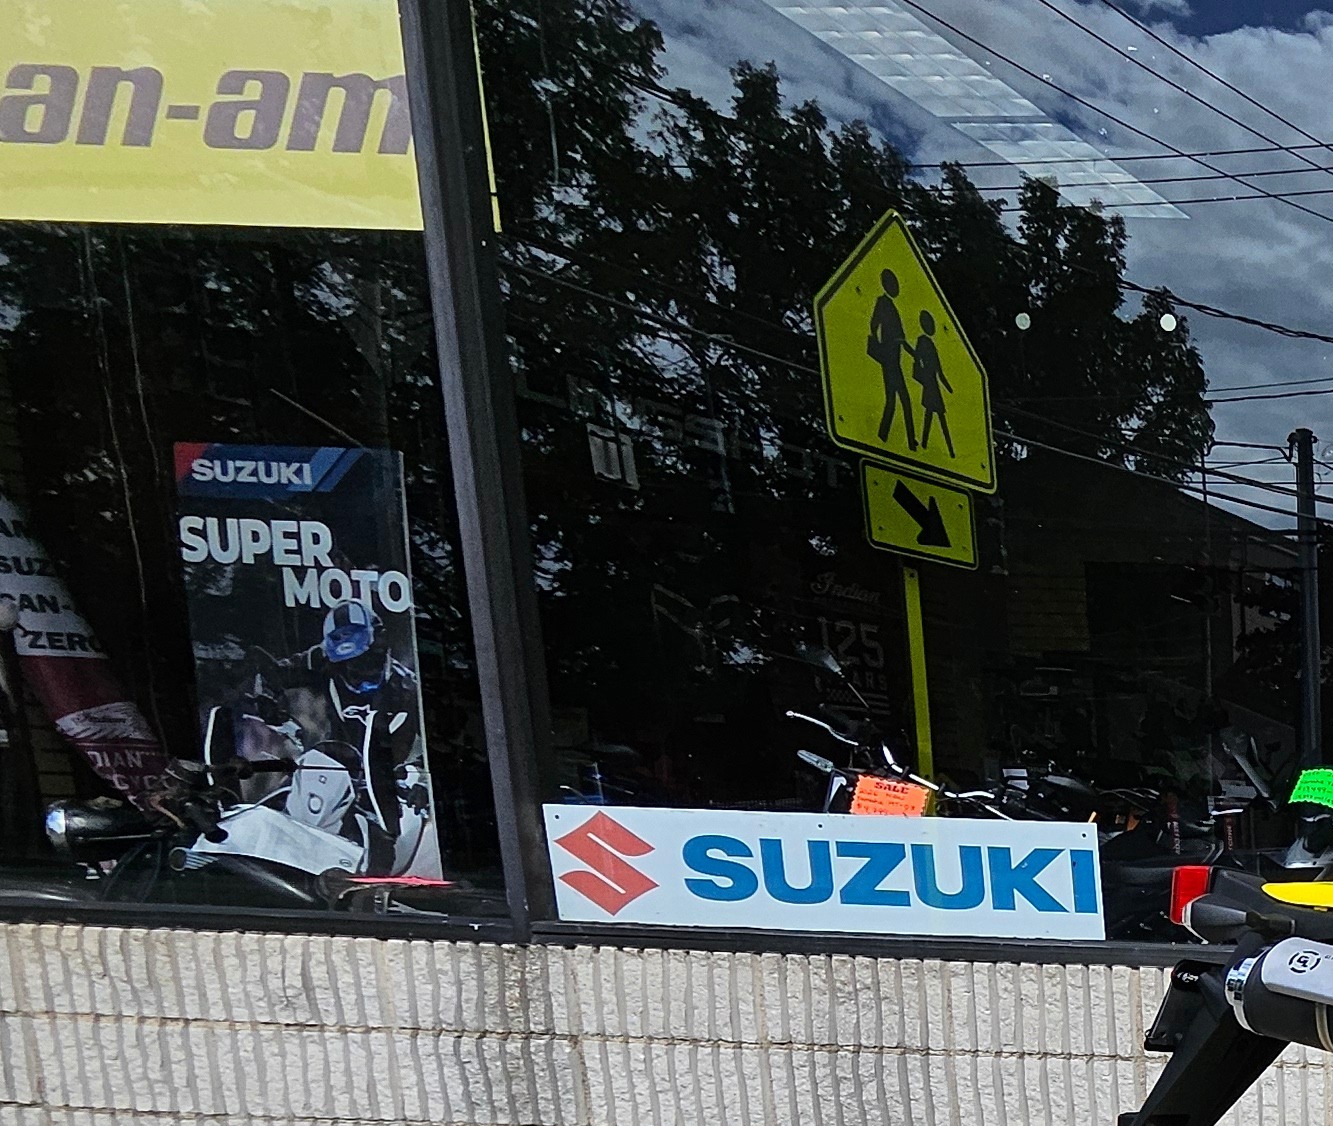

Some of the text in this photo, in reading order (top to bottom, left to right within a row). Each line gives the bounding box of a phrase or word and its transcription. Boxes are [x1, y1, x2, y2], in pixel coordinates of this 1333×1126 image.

[192, 458, 313, 485] SUZUKI
[179, 516, 334, 567] SUPER
[283, 567, 412, 613] MOTO
[874, 782, 910, 794] SALE
[682, 834, 1099, 914] SUZUKI
